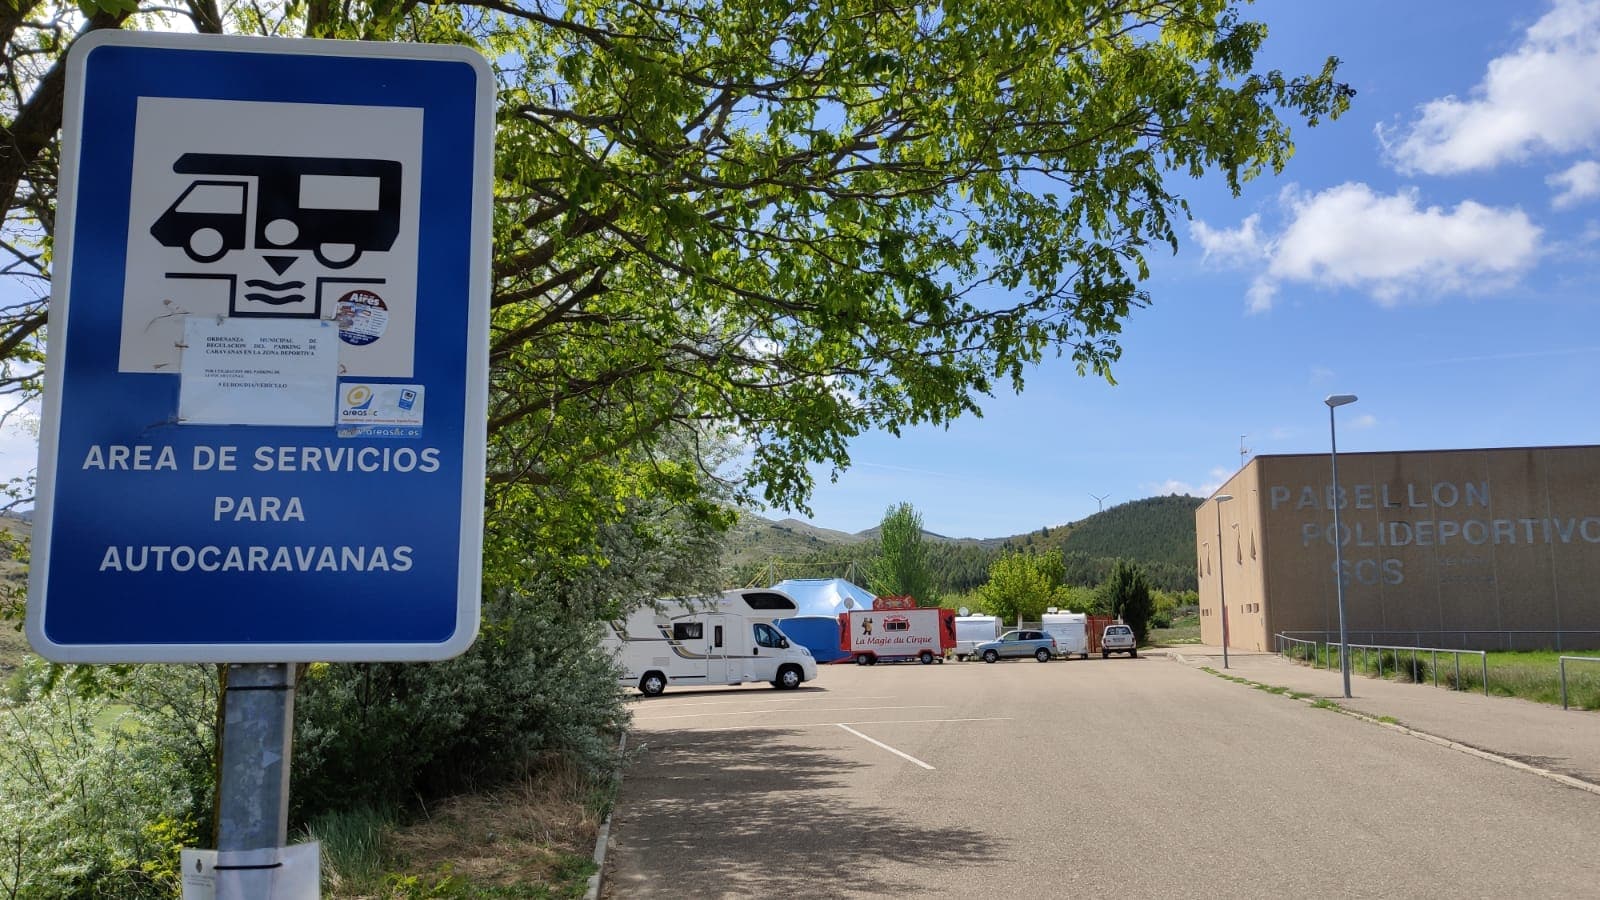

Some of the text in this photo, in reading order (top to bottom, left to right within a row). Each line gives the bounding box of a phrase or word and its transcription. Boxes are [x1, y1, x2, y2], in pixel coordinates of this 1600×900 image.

[82, 445, 441, 473] AREA DE SERVICIOS
[213, 496, 305, 522] PARA
[1270, 481, 1491, 511] PABELLON
[1302, 515, 1600, 548] POLIDEPORTIVO
[99, 545, 414, 572] AUTOCARAVANAS
[855, 635, 932, 647] La Magie du Cirque
